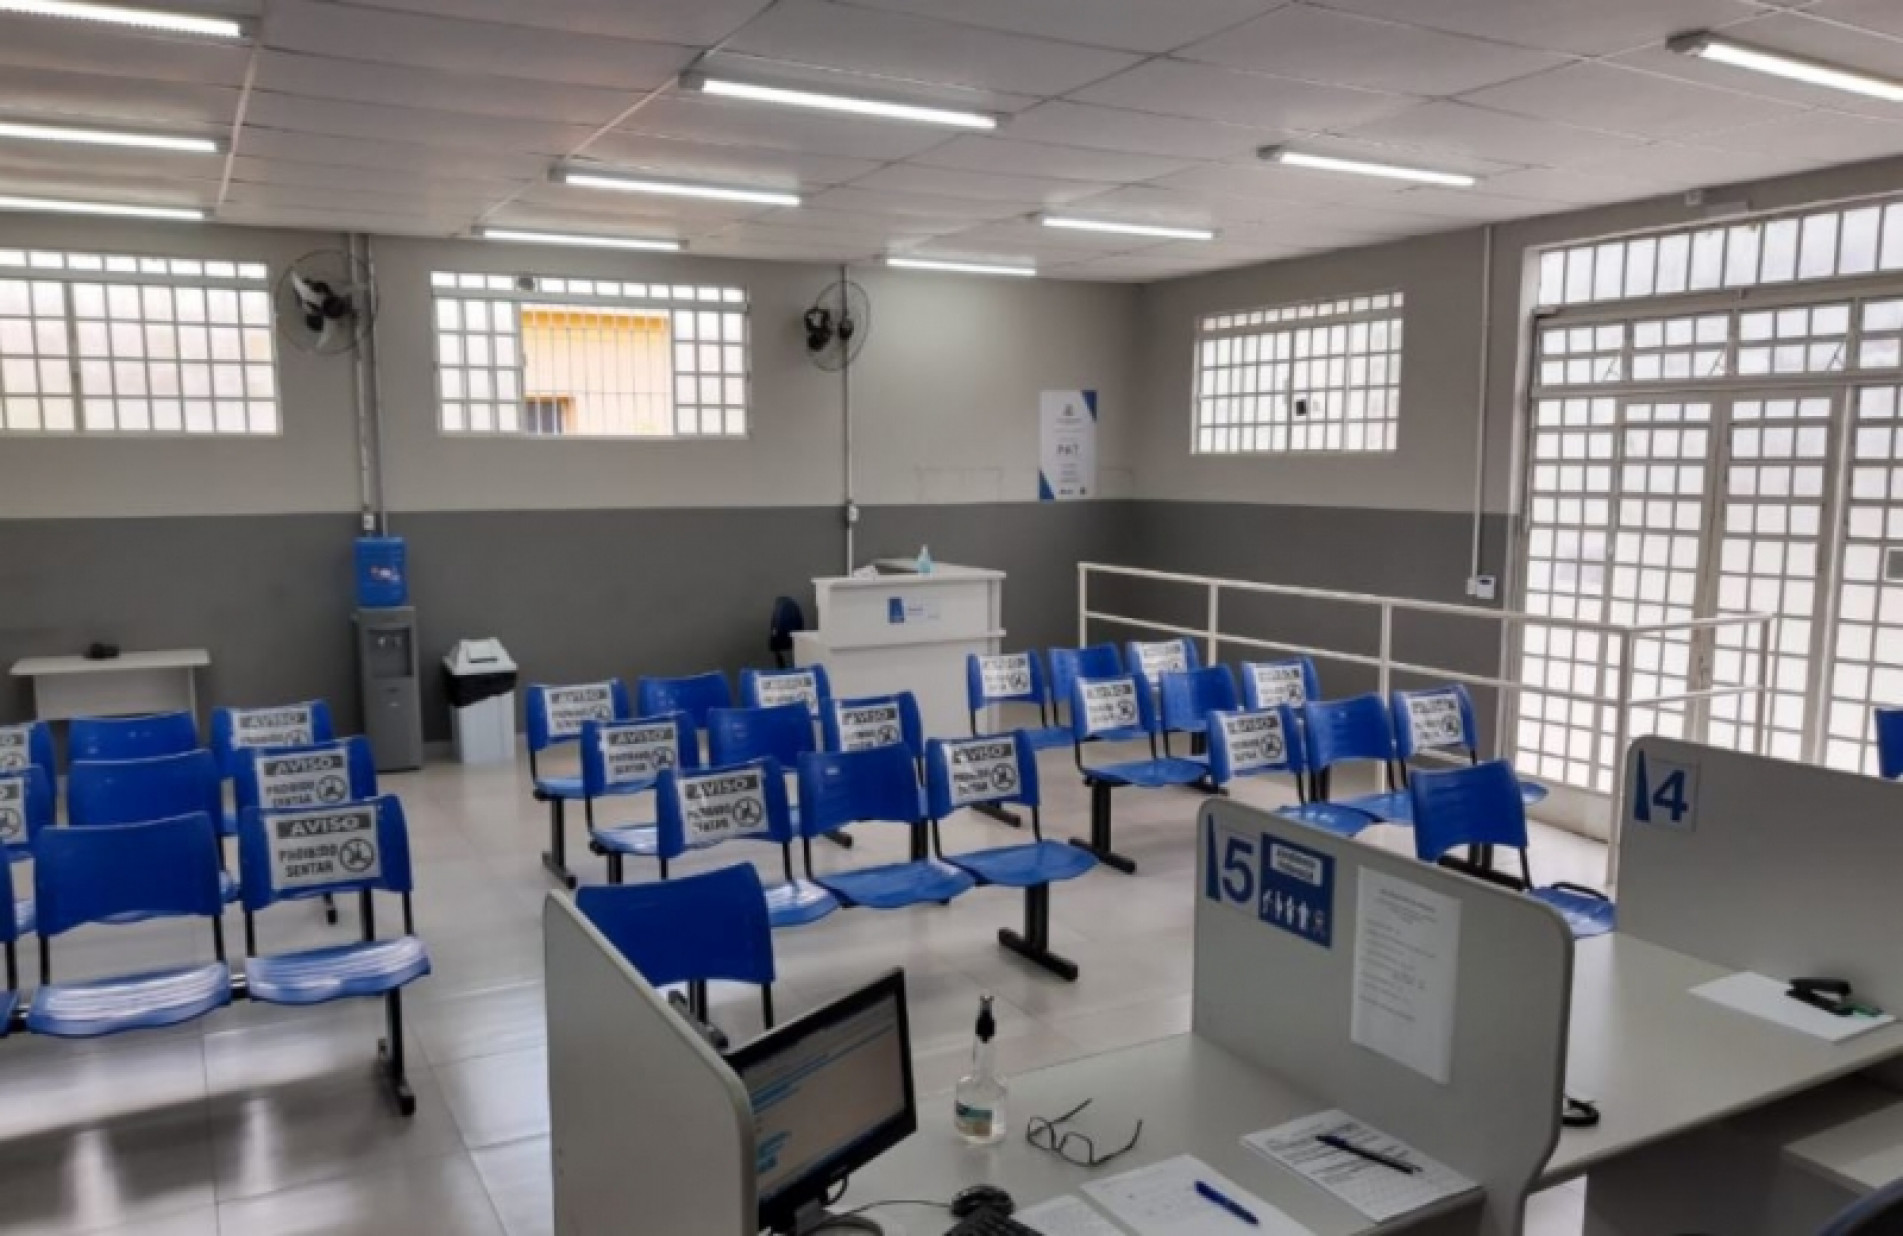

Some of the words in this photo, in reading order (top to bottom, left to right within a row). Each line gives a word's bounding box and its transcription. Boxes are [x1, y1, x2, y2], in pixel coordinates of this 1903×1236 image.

[275, 756, 332, 776] AVISO
[1653, 769, 1689, 822] 4
[291, 815, 359, 837] AVISO
[285, 860, 334, 877] SENTAR
[1222, 836, 1254, 903] 5
